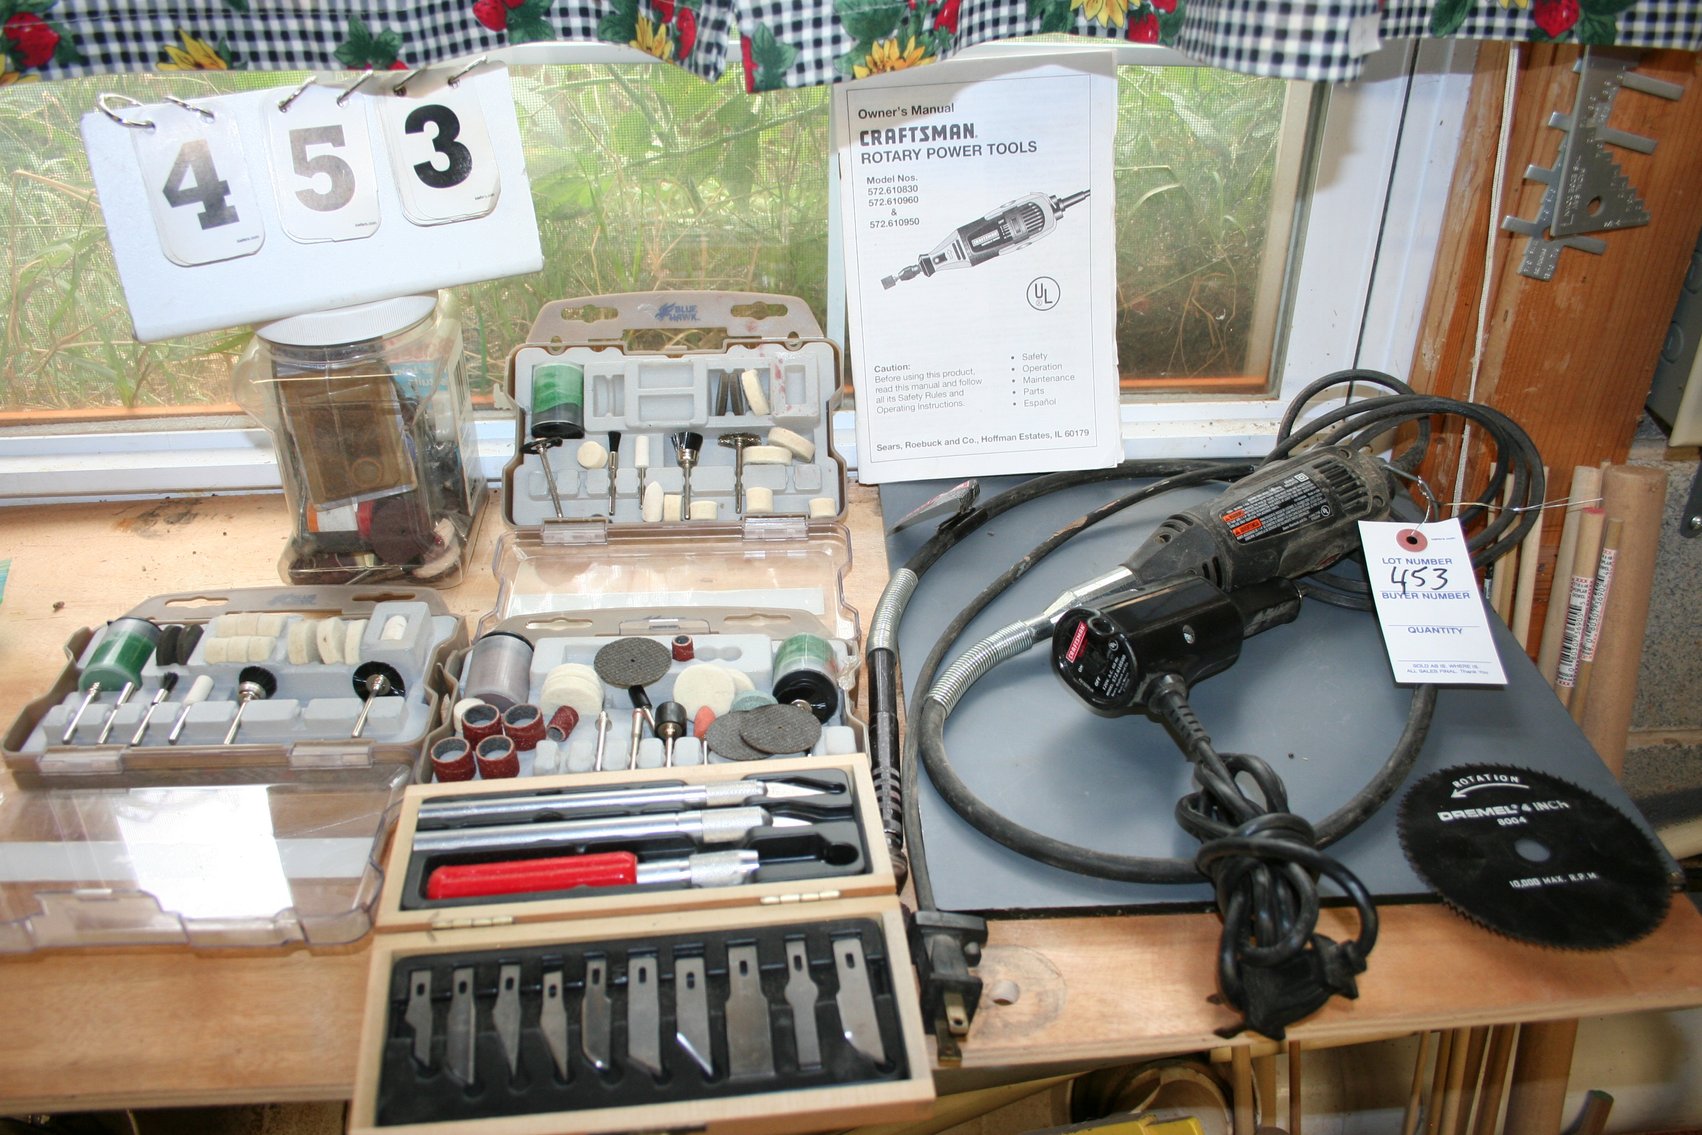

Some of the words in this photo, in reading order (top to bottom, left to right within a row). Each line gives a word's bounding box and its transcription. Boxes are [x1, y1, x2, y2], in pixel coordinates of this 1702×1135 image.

[858, 107, 908, 120] Owner's
[912, 103, 955, 116] Manual
[859, 123, 977, 147] CRAFTSMAN
[861, 149, 921, 164] ROTARY
[927, 145, 982, 159] POWER
[987, 141, 1037, 155] TOOLS
[866, 175, 895, 184] Model
[897, 174, 918, 182] Nos.
[867, 184, 919, 196] 572.610830
[868, 196, 919, 207] 572.610960
[891, 208, 897, 216] &
[869, 217, 920, 229] 572.610950
[1022, 352, 1048, 361] Safety
[874, 364, 911, 373] Caution:
[1022, 363, 1063, 373] Operation
[874, 375, 901, 383] Before
[902, 372, 925, 381] using
[926, 371, 940, 379] this
[942, 368, 975, 378] product,
[1022, 375, 1075, 384] Maintenance
[895, 384, 909, 392] this
[911, 381, 940, 390] manual
[942, 379, 957, 387] and
[959, 378, 983, 386] follow
[1023, 387, 1045, 395] Parts
[876, 396, 885, 404] all
[886, 395, 896, 403] its
[898, 393, 923, 402] Safety
[925, 390, 947, 399] Rules
[949, 389, 964, 397] and
[876, 404, 916, 414] Operating
[917, 401, 965, 411] Instructions.
[876, 443, 903, 452] Sears,
[905, 440, 942, 449] Roebuck
[944, 438, 960, 446] and
[962, 436, 979, 445] Co.,
[981, 433, 1017, 443] Hoffman
[1019, 431, 1052, 441] Estates,
[1064, 429, 1090, 438] 60179
[1391, 566, 1448, 594] 453
[1381, 592, 1418, 600] BUYER
[1422, 592, 1471, 600] NUMBER
[1407, 626, 1462, 634] QUANTITY
[1451, 773, 1520, 789] ROTATION
[1521, 803, 1532, 812] 4
[1508, 877, 1541, 888] 10,000
[1541, 875, 1567, 884] MAX.
